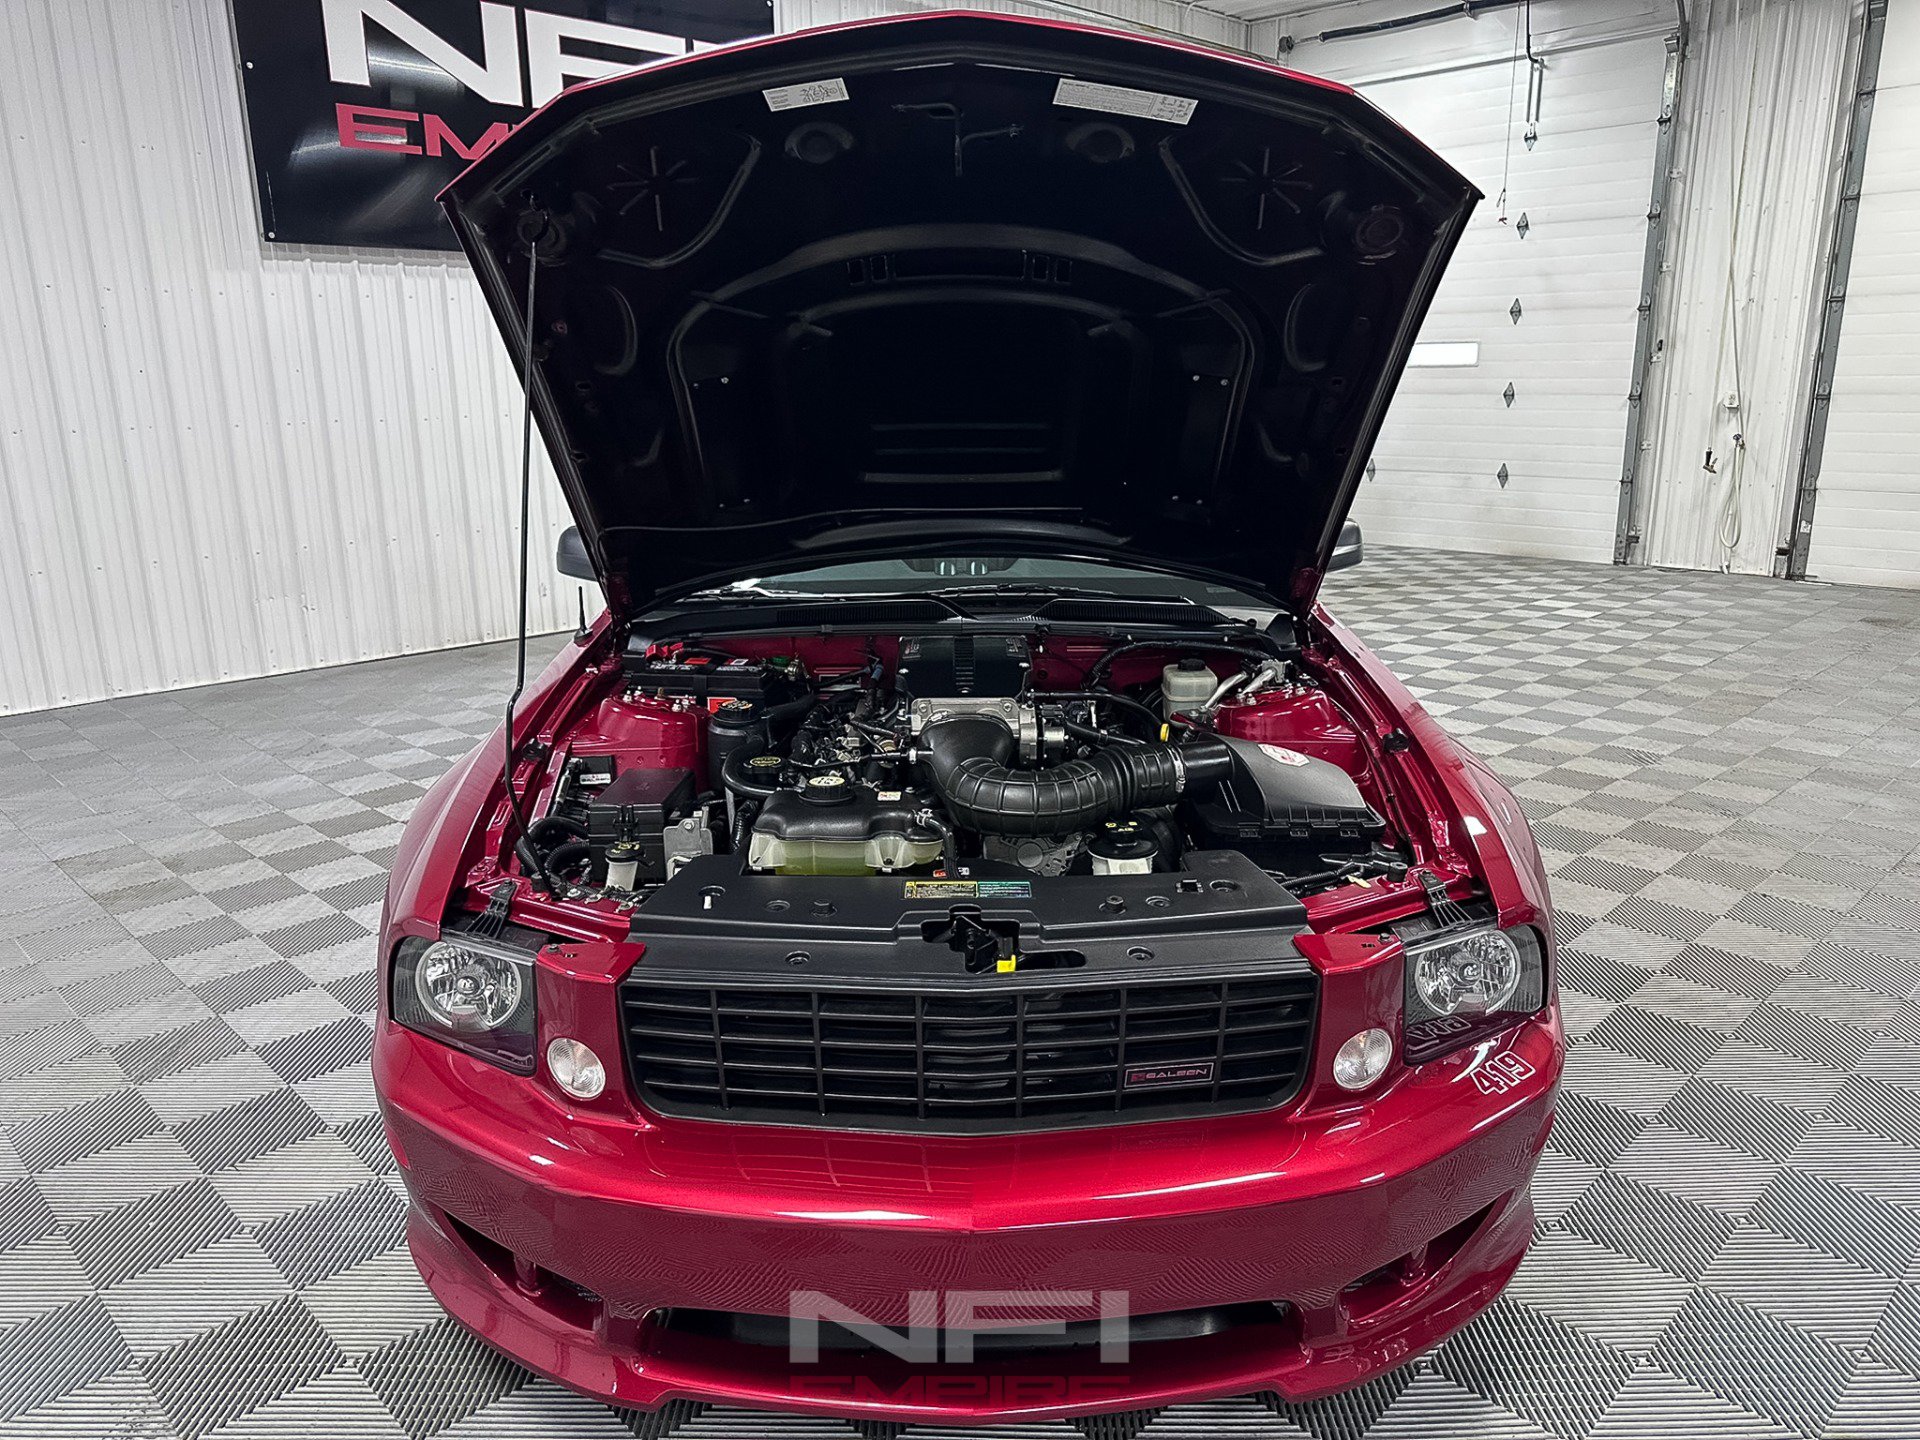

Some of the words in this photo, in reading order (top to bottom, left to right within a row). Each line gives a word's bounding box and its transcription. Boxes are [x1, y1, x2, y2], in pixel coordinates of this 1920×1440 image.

[322, 0, 722, 109] NF
[335, 103, 519, 161] EM
[1470, 1050, 1536, 1095] 419
